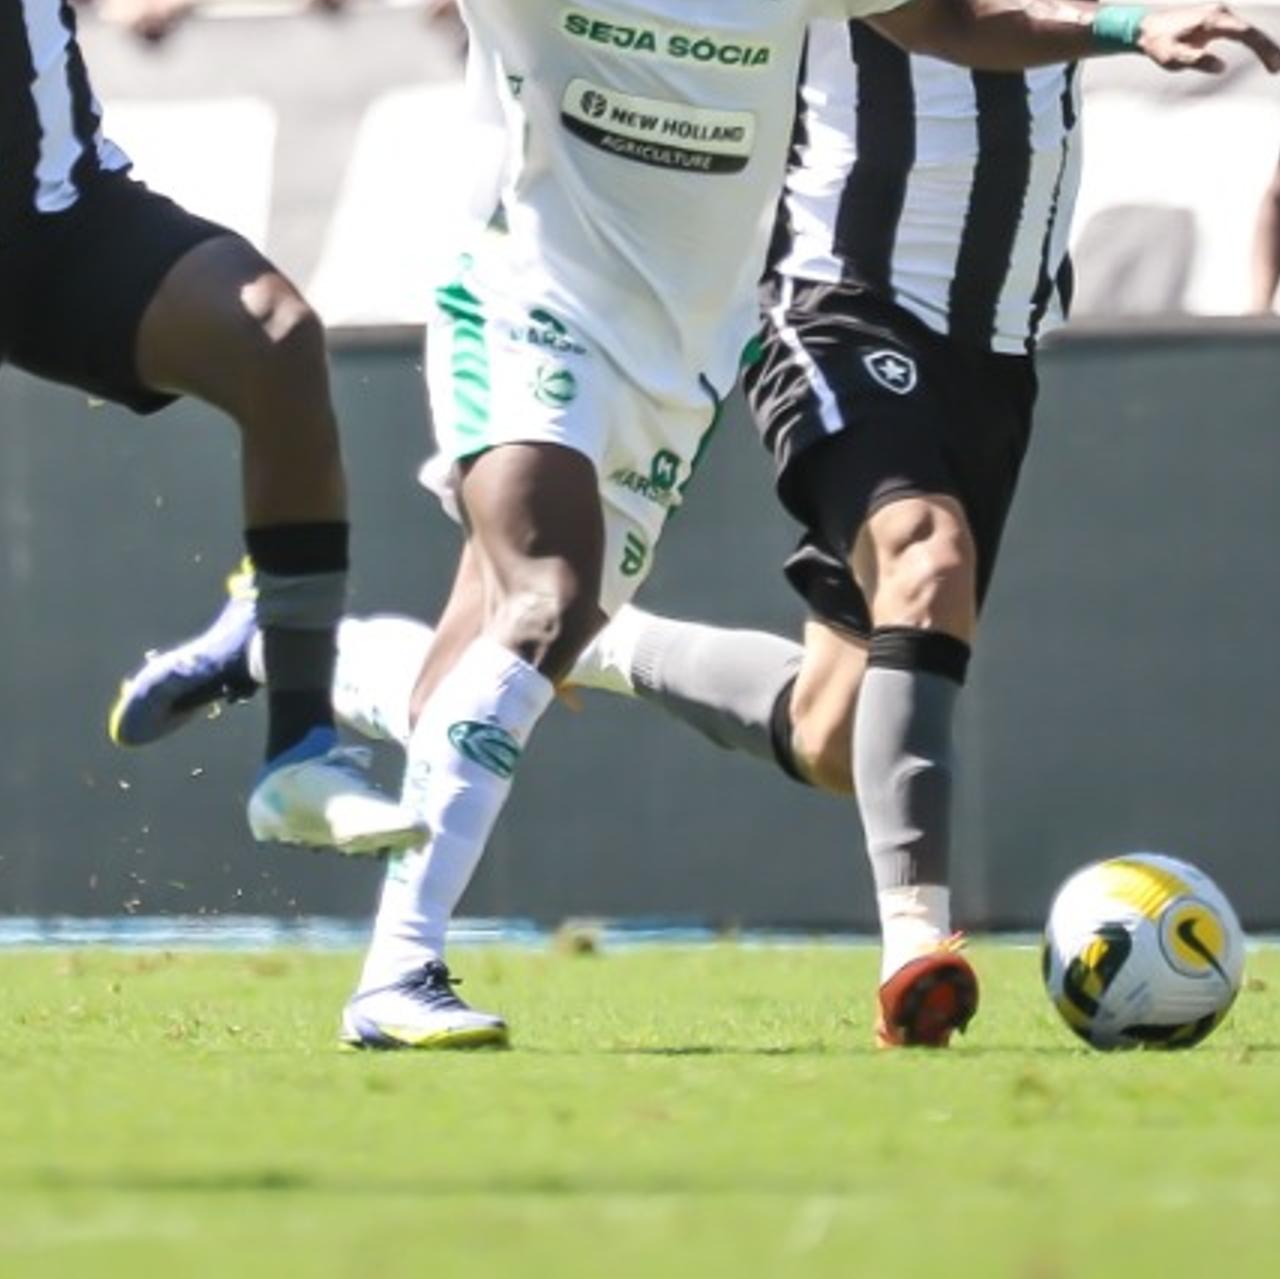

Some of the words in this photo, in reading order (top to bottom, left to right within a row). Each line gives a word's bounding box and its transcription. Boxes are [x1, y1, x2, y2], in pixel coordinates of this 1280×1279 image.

[564, 14, 656, 52] SEJA
[667, 34, 771, 66] SÓCIA
[610, 106, 659, 131] NEW
[661, 119, 746, 142] HOLLAND
[600, 135, 713, 170] AGRICULTURE
